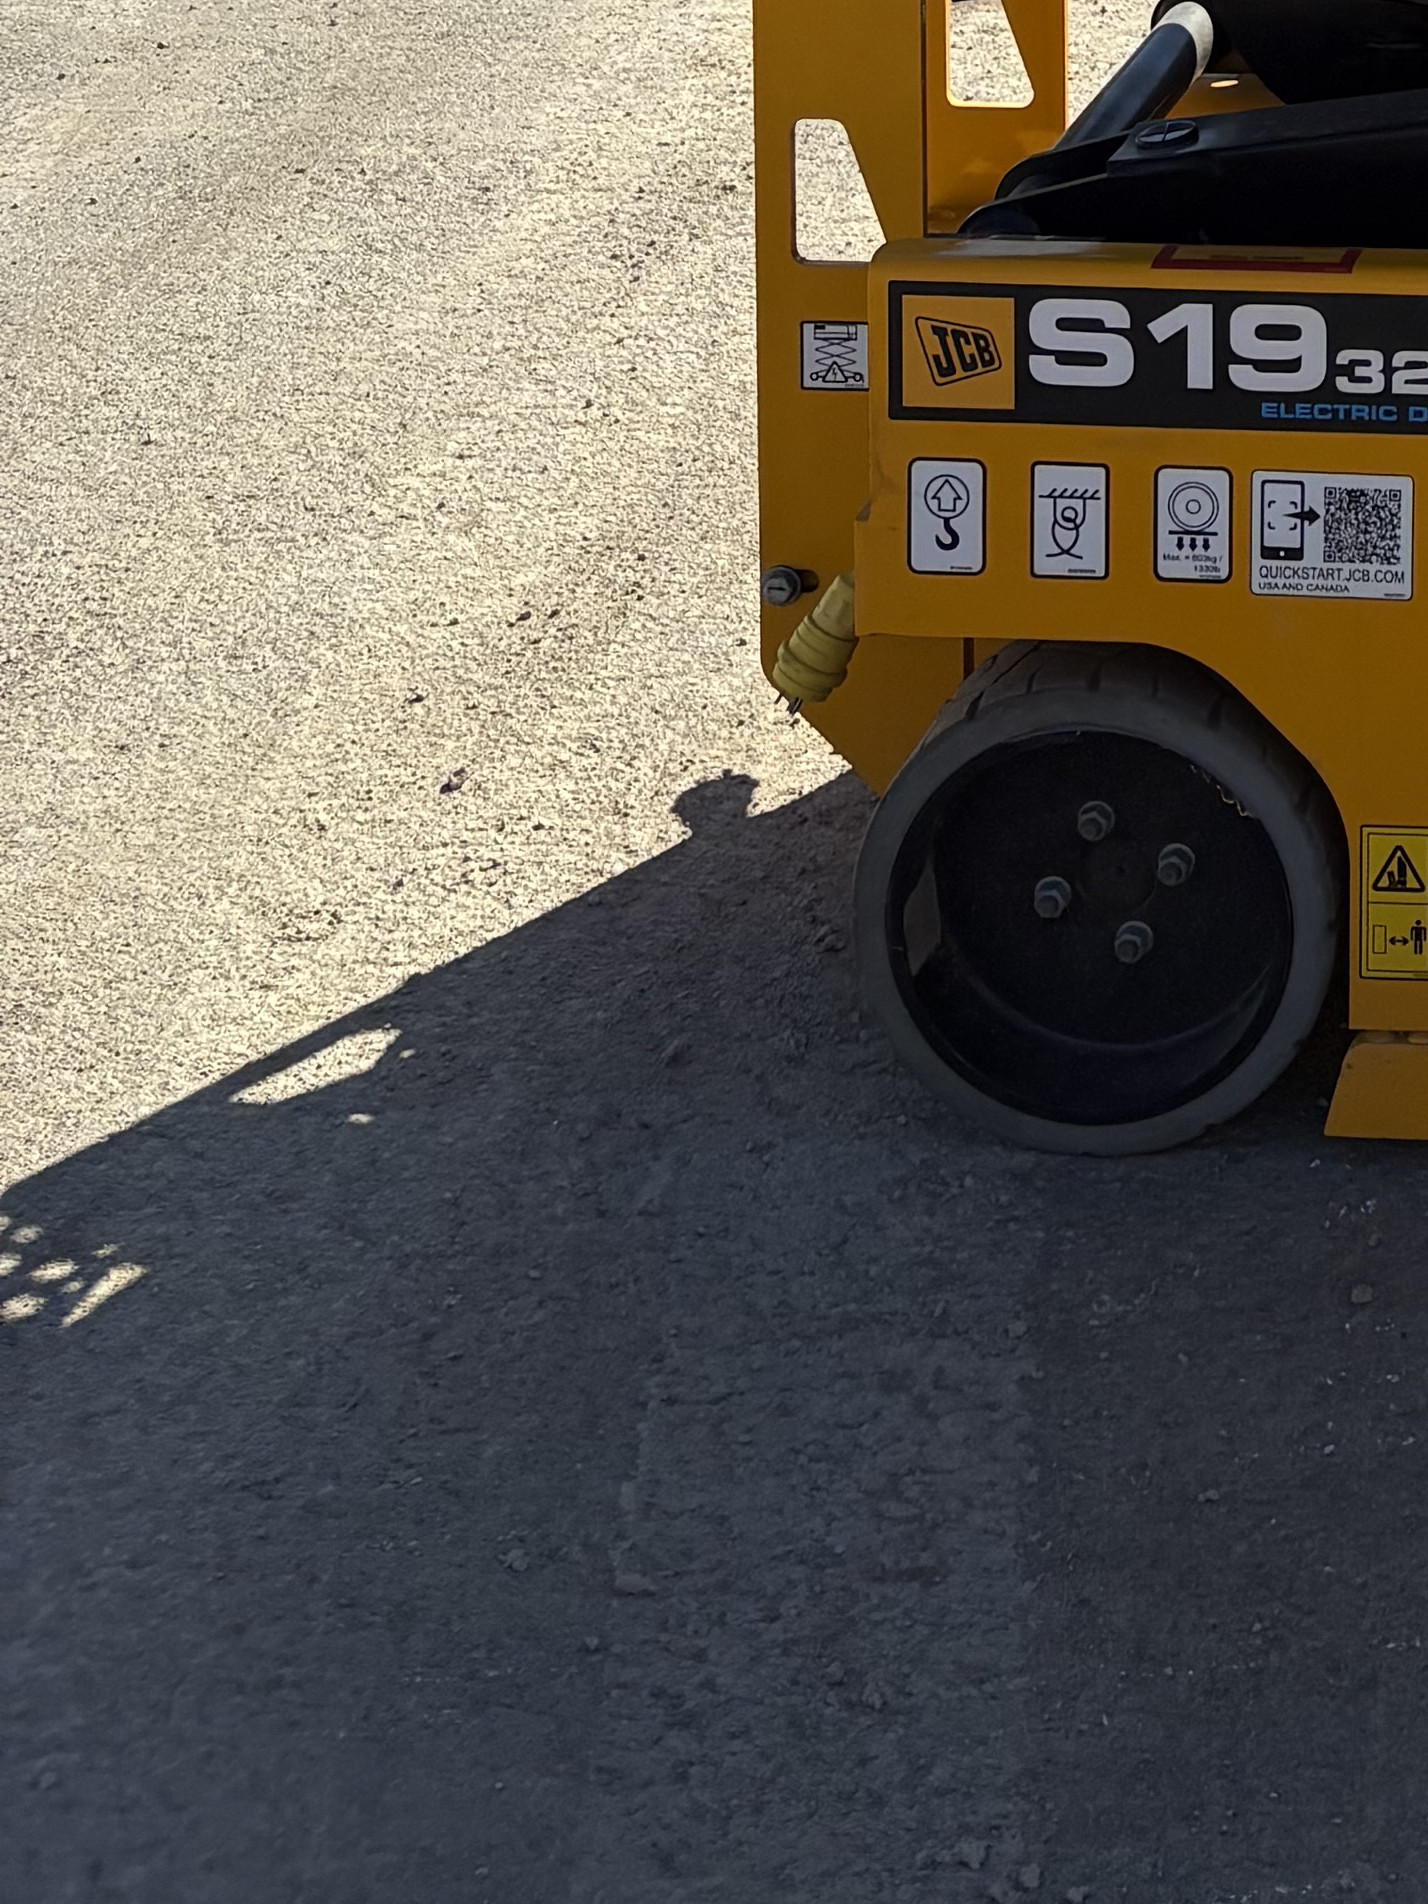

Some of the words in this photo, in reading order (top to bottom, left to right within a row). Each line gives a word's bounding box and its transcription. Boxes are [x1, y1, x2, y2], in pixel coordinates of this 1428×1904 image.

[931, 324, 996, 379] JCB
[1261, 402, 1398, 422] ELECTRIC
[1259, 565, 1405, 584] QUICKSTART.JCB.COM
[1258, 582, 1278, 591] USA
[1281, 583, 1303, 592] AND
[1306, 584, 1350, 593] CANADA
